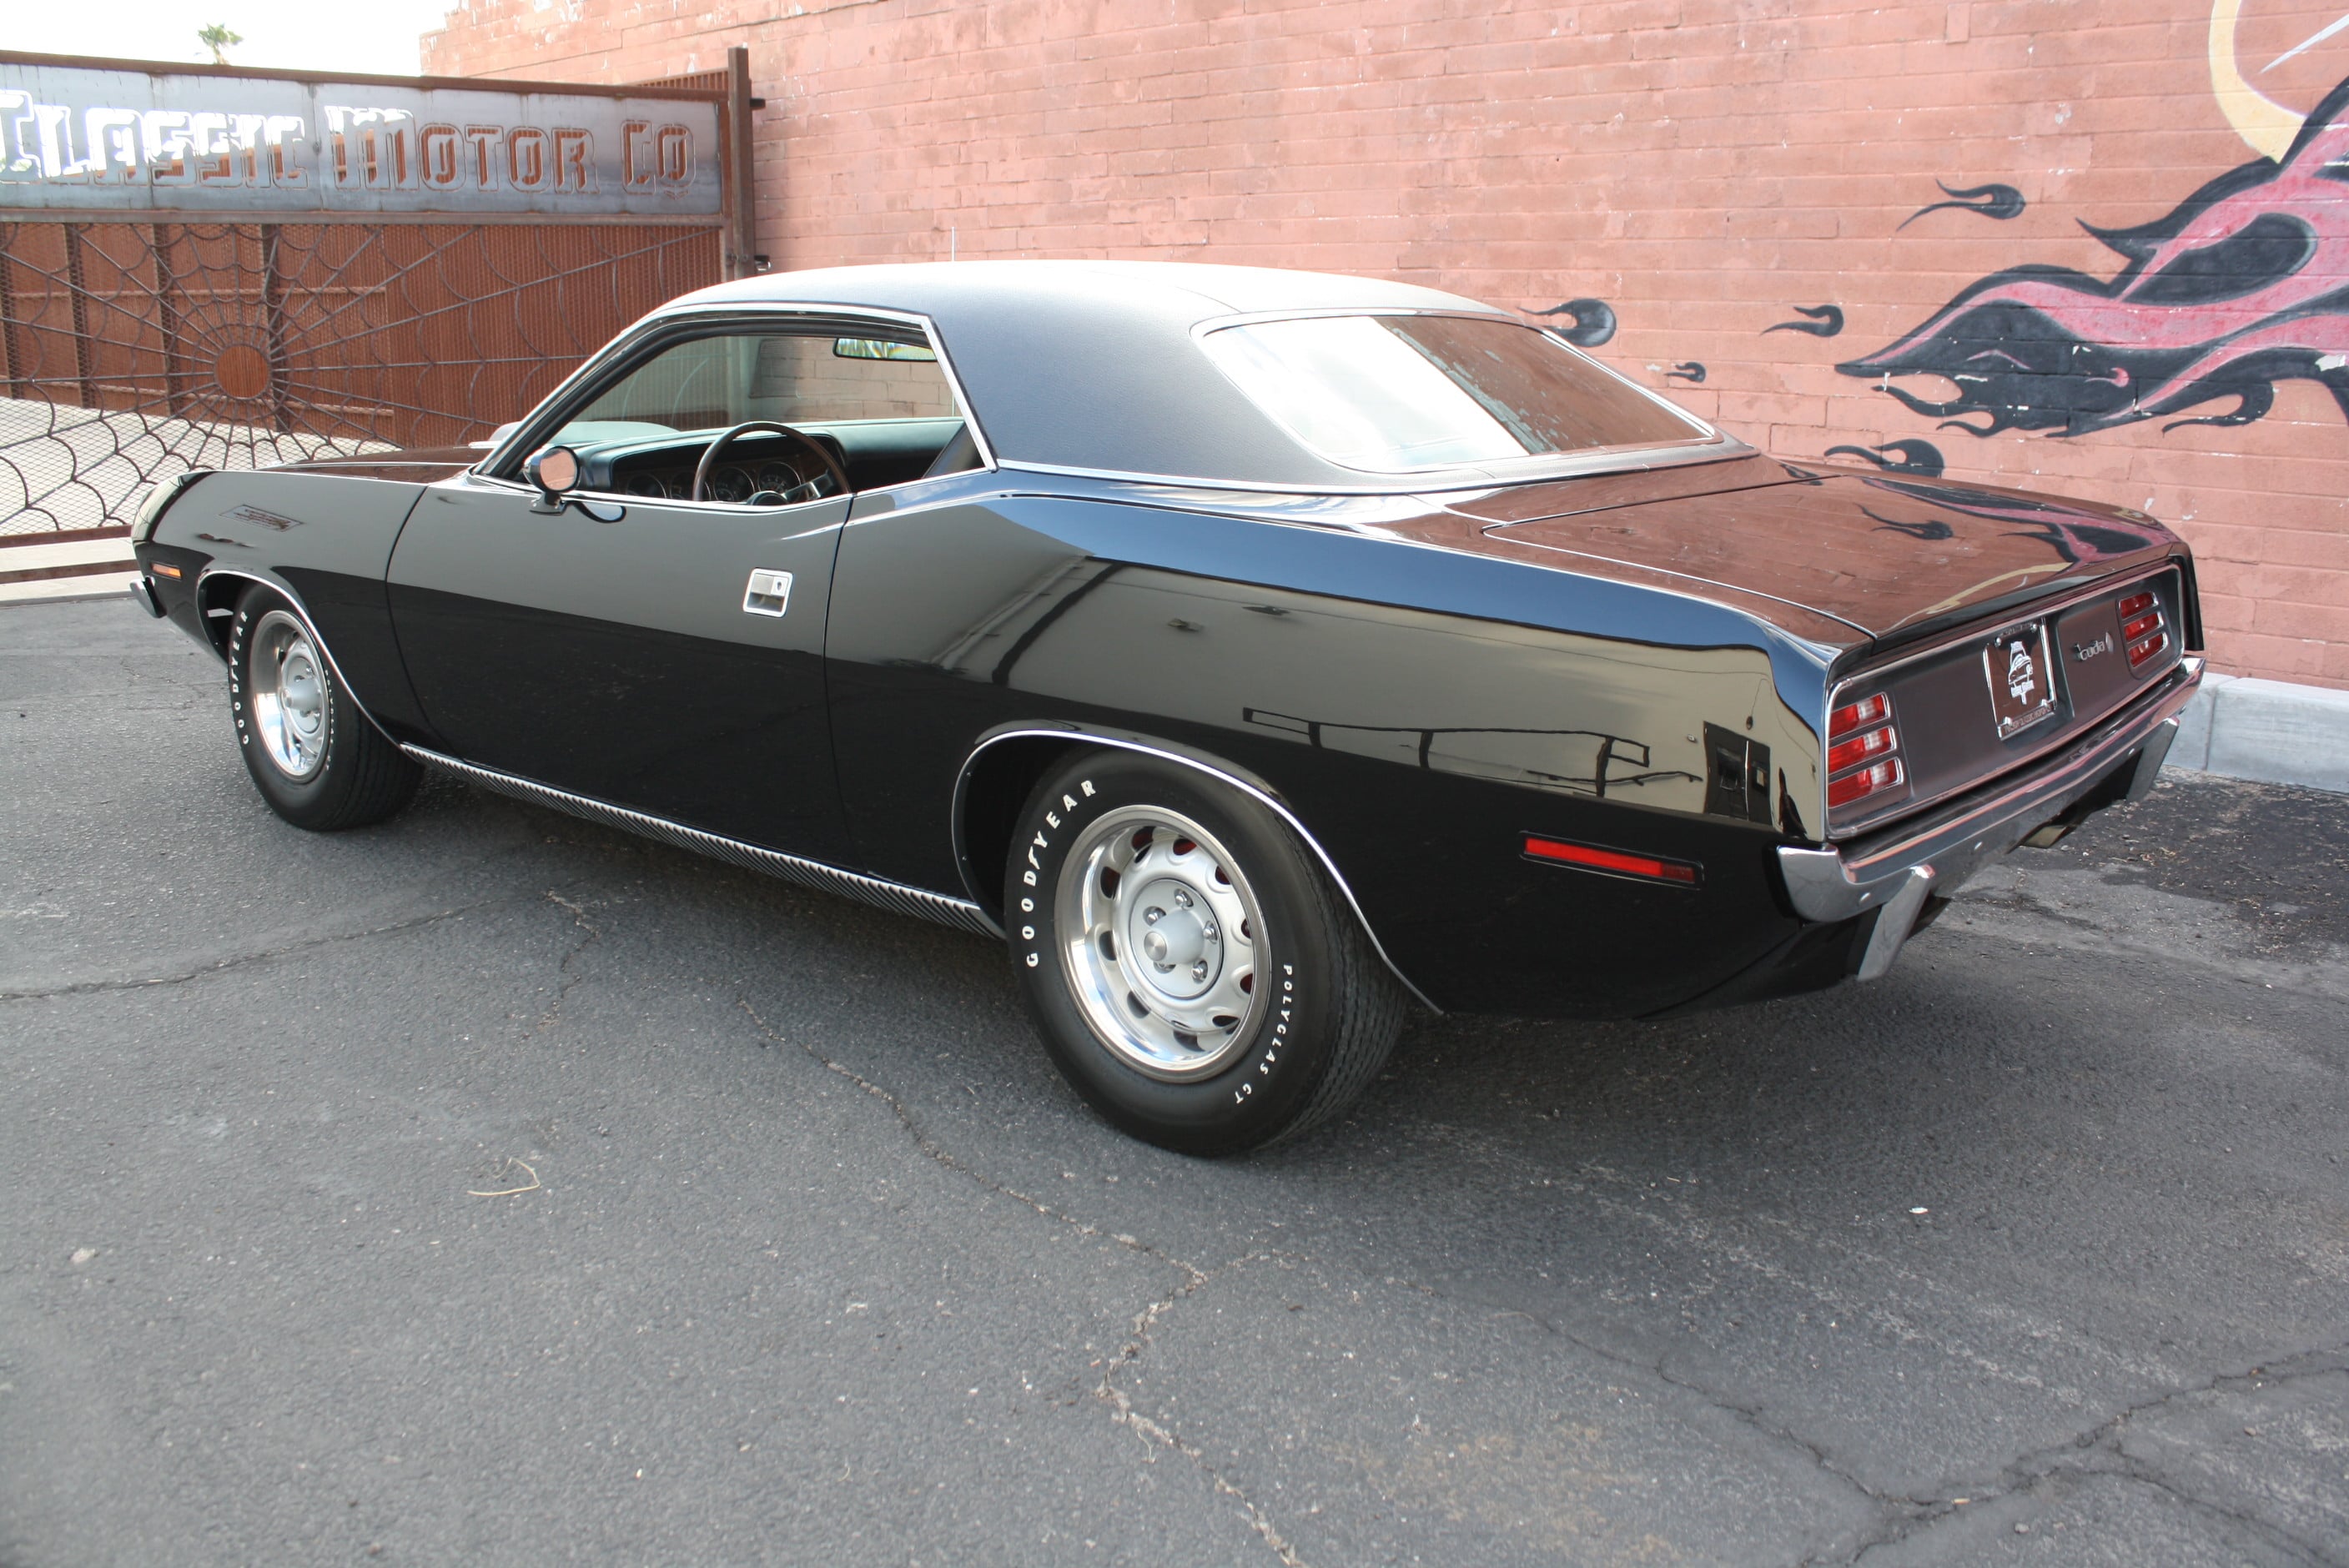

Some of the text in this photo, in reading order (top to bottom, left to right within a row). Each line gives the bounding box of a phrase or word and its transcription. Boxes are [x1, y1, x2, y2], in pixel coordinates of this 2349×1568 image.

[324, 105, 601, 194] MOTOR
[620, 119, 697, 195] CO
[231, 611, 249, 745] GOODYEAR
[1020, 779, 1097, 967] GOODYEAR
[1233, 964, 1293, 1104] POLYGLAS GT
